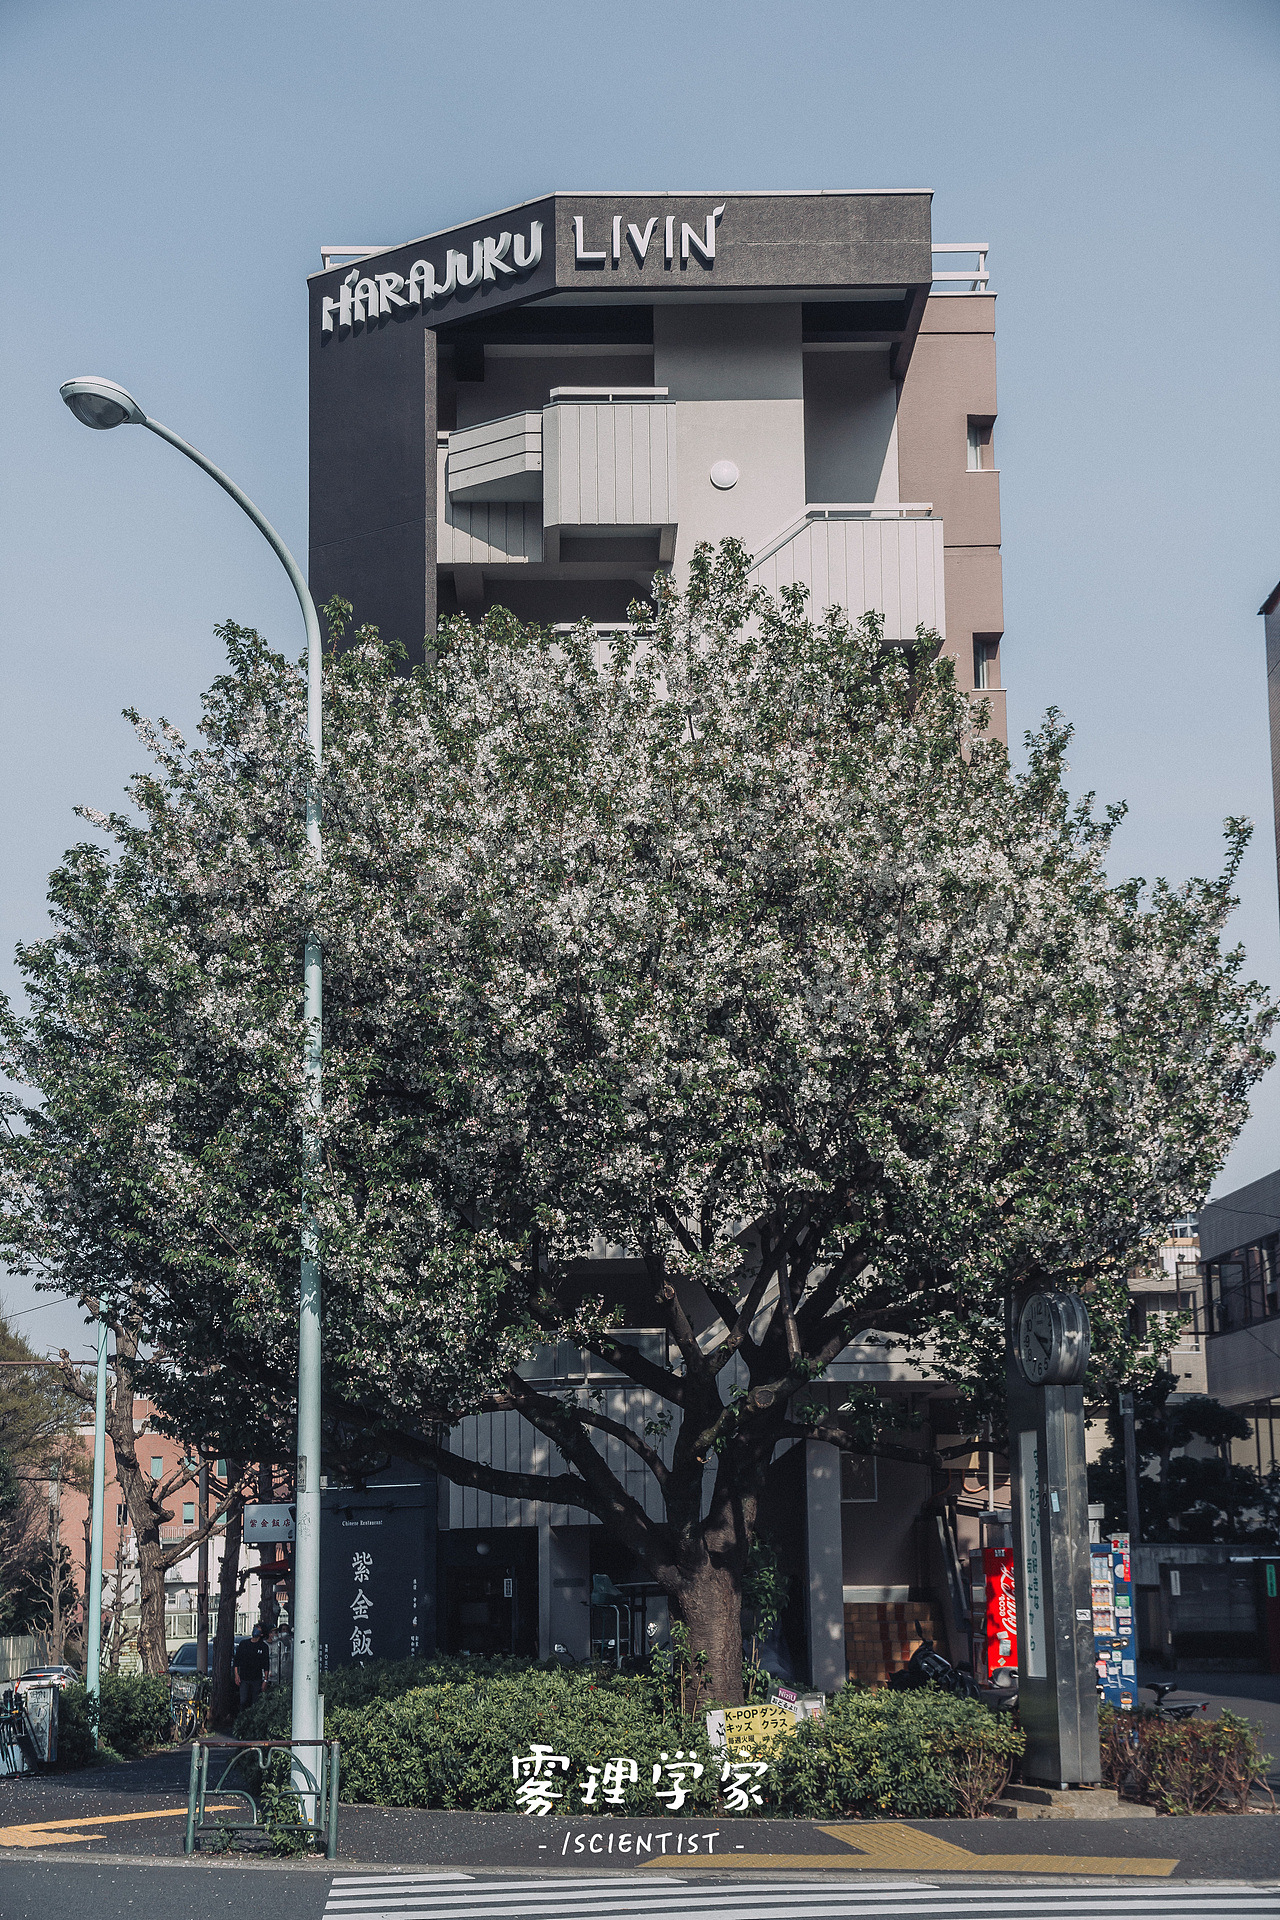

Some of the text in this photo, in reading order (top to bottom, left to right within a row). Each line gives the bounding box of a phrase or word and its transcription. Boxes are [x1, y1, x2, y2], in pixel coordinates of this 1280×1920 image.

[321, 220, 544, 332] HARAJUKU
[1037, 1362, 1043, 1376] 6
[249, 1518, 292, 1528] 紫金飯店
[350, 1551, 374, 1669] 紫金飯
[778, 1689, 796, 1702] NiziU
[725, 1708, 759, 1721] K-POP
[726, 1718, 789, 1734] キッズ クラス
